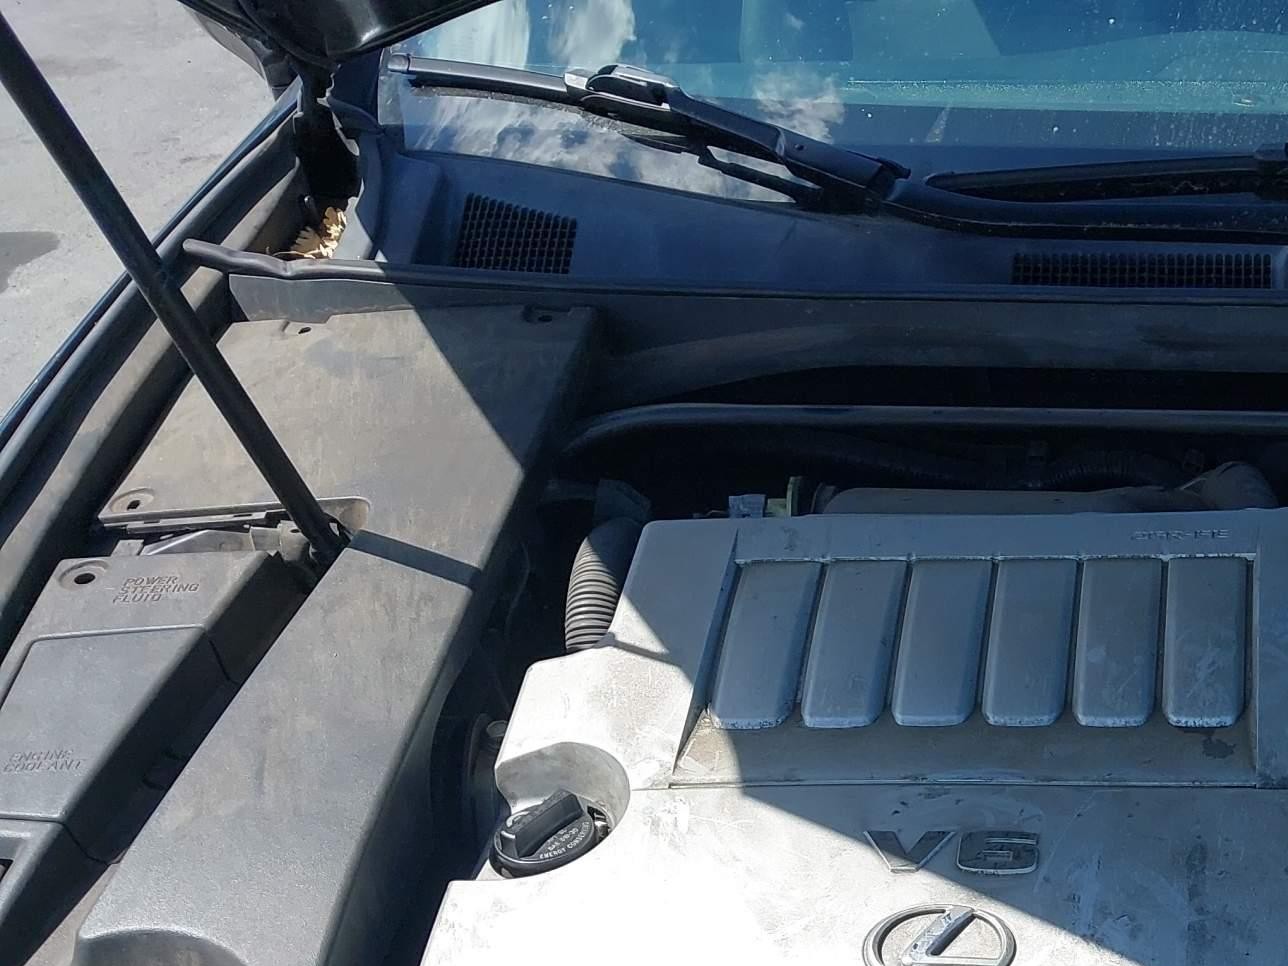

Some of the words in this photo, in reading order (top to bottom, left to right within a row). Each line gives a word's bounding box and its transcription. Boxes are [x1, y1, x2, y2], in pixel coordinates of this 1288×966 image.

[123, 575, 179, 587] POWER
[120, 583, 199, 594] STEERING
[112, 593, 162, 603] FLUID
[863, 829, 1041, 876] V6
